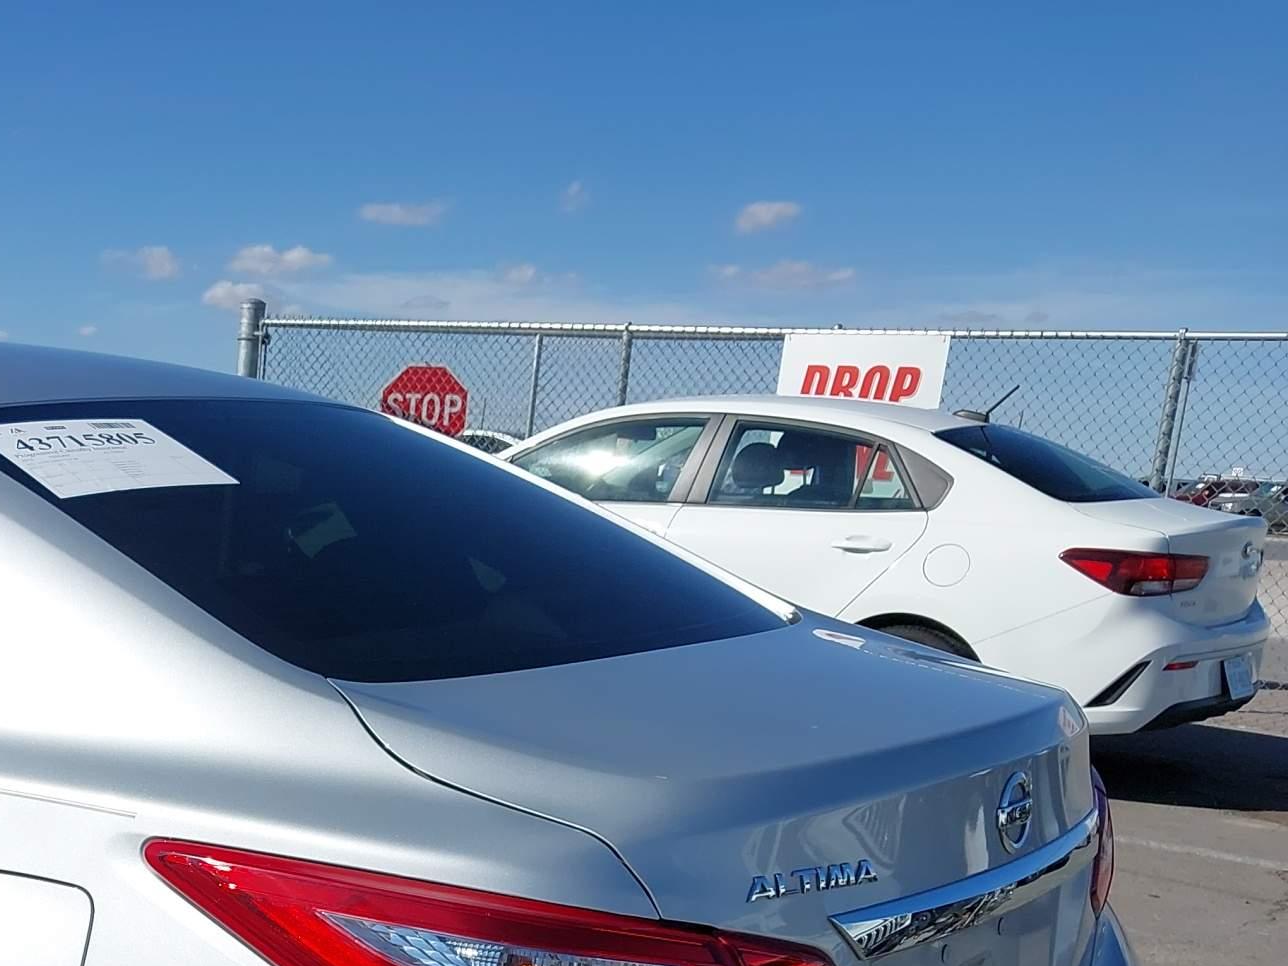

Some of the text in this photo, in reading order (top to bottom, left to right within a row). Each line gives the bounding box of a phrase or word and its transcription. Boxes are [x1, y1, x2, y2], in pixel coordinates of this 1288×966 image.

[799, 364, 922, 402] DROP
[386, 391, 463, 427] STOP
[15, 432, 155, 452] 43715805
[745, 859, 879, 903] ALTIMA
